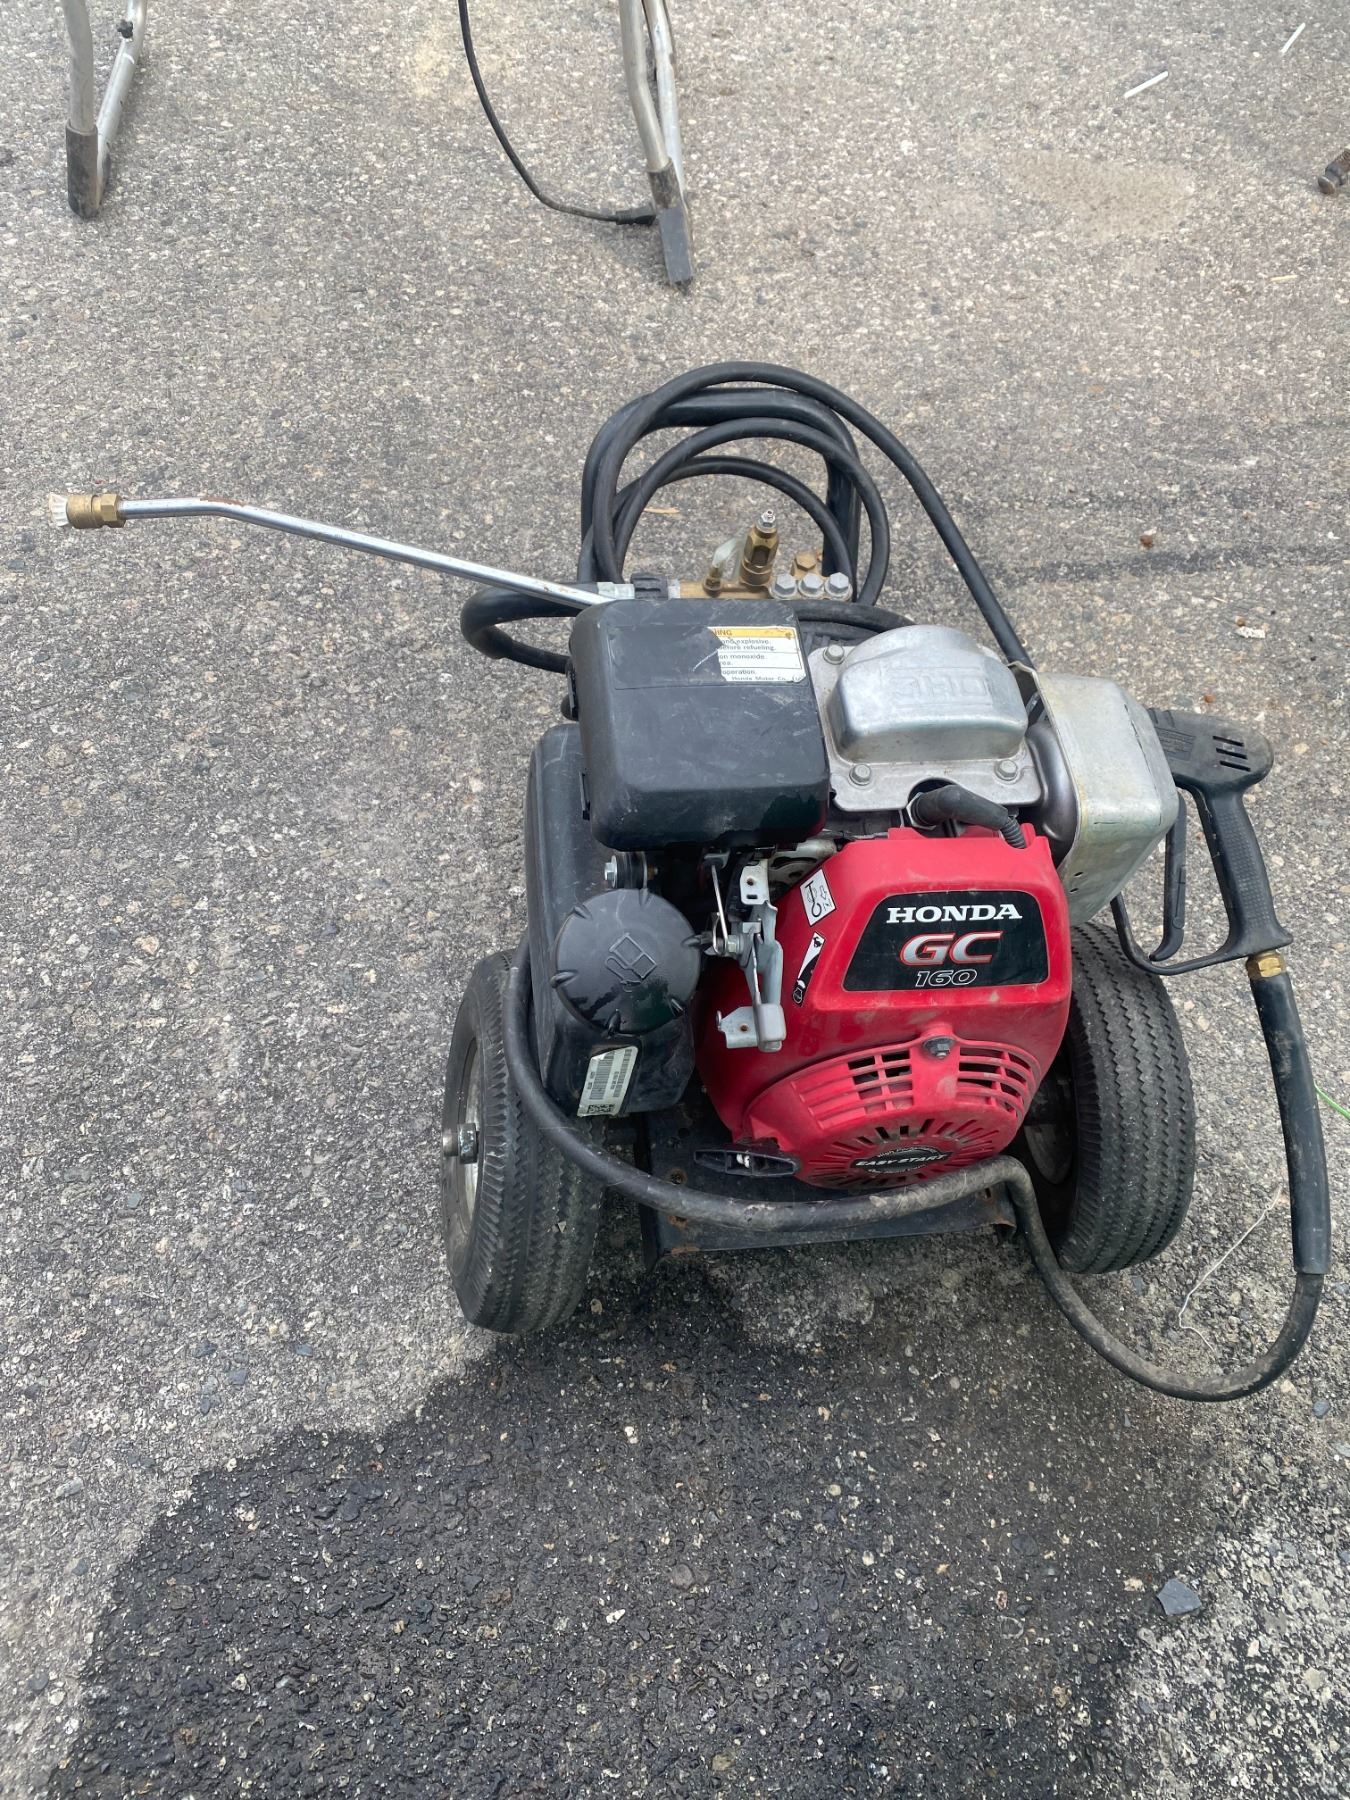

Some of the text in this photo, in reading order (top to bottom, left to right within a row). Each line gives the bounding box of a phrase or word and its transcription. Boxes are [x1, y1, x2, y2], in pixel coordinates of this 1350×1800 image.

[886, 904, 1023, 924] HONDA
[900, 930, 1004, 967] GC
[915, 969, 978, 988] 160
[897, 1154, 948, 1163] START
